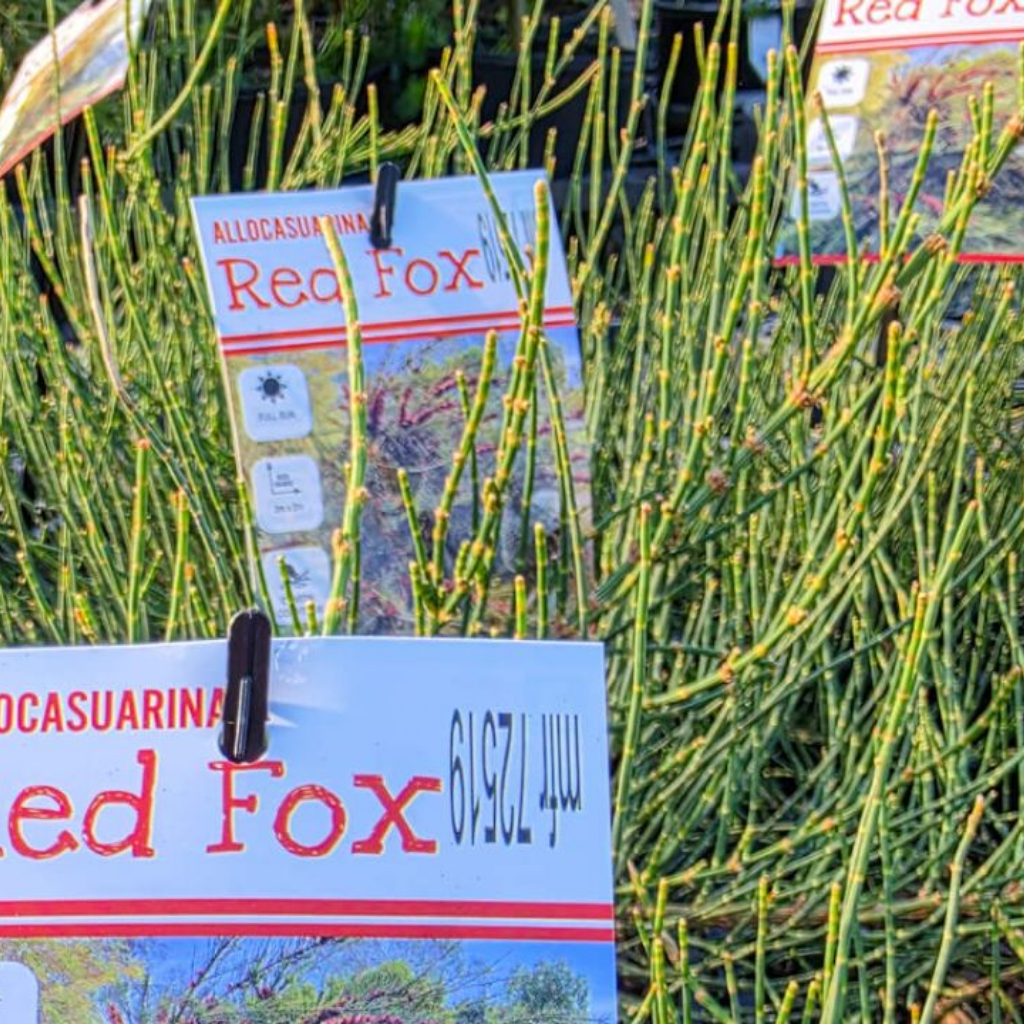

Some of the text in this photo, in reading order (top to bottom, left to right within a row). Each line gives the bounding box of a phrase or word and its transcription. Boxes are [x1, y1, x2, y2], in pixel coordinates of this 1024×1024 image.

[366, 247, 485, 299] Fox
[206, 760, 443, 857] Fox
[449, 707, 583, 849] mfr 72519
